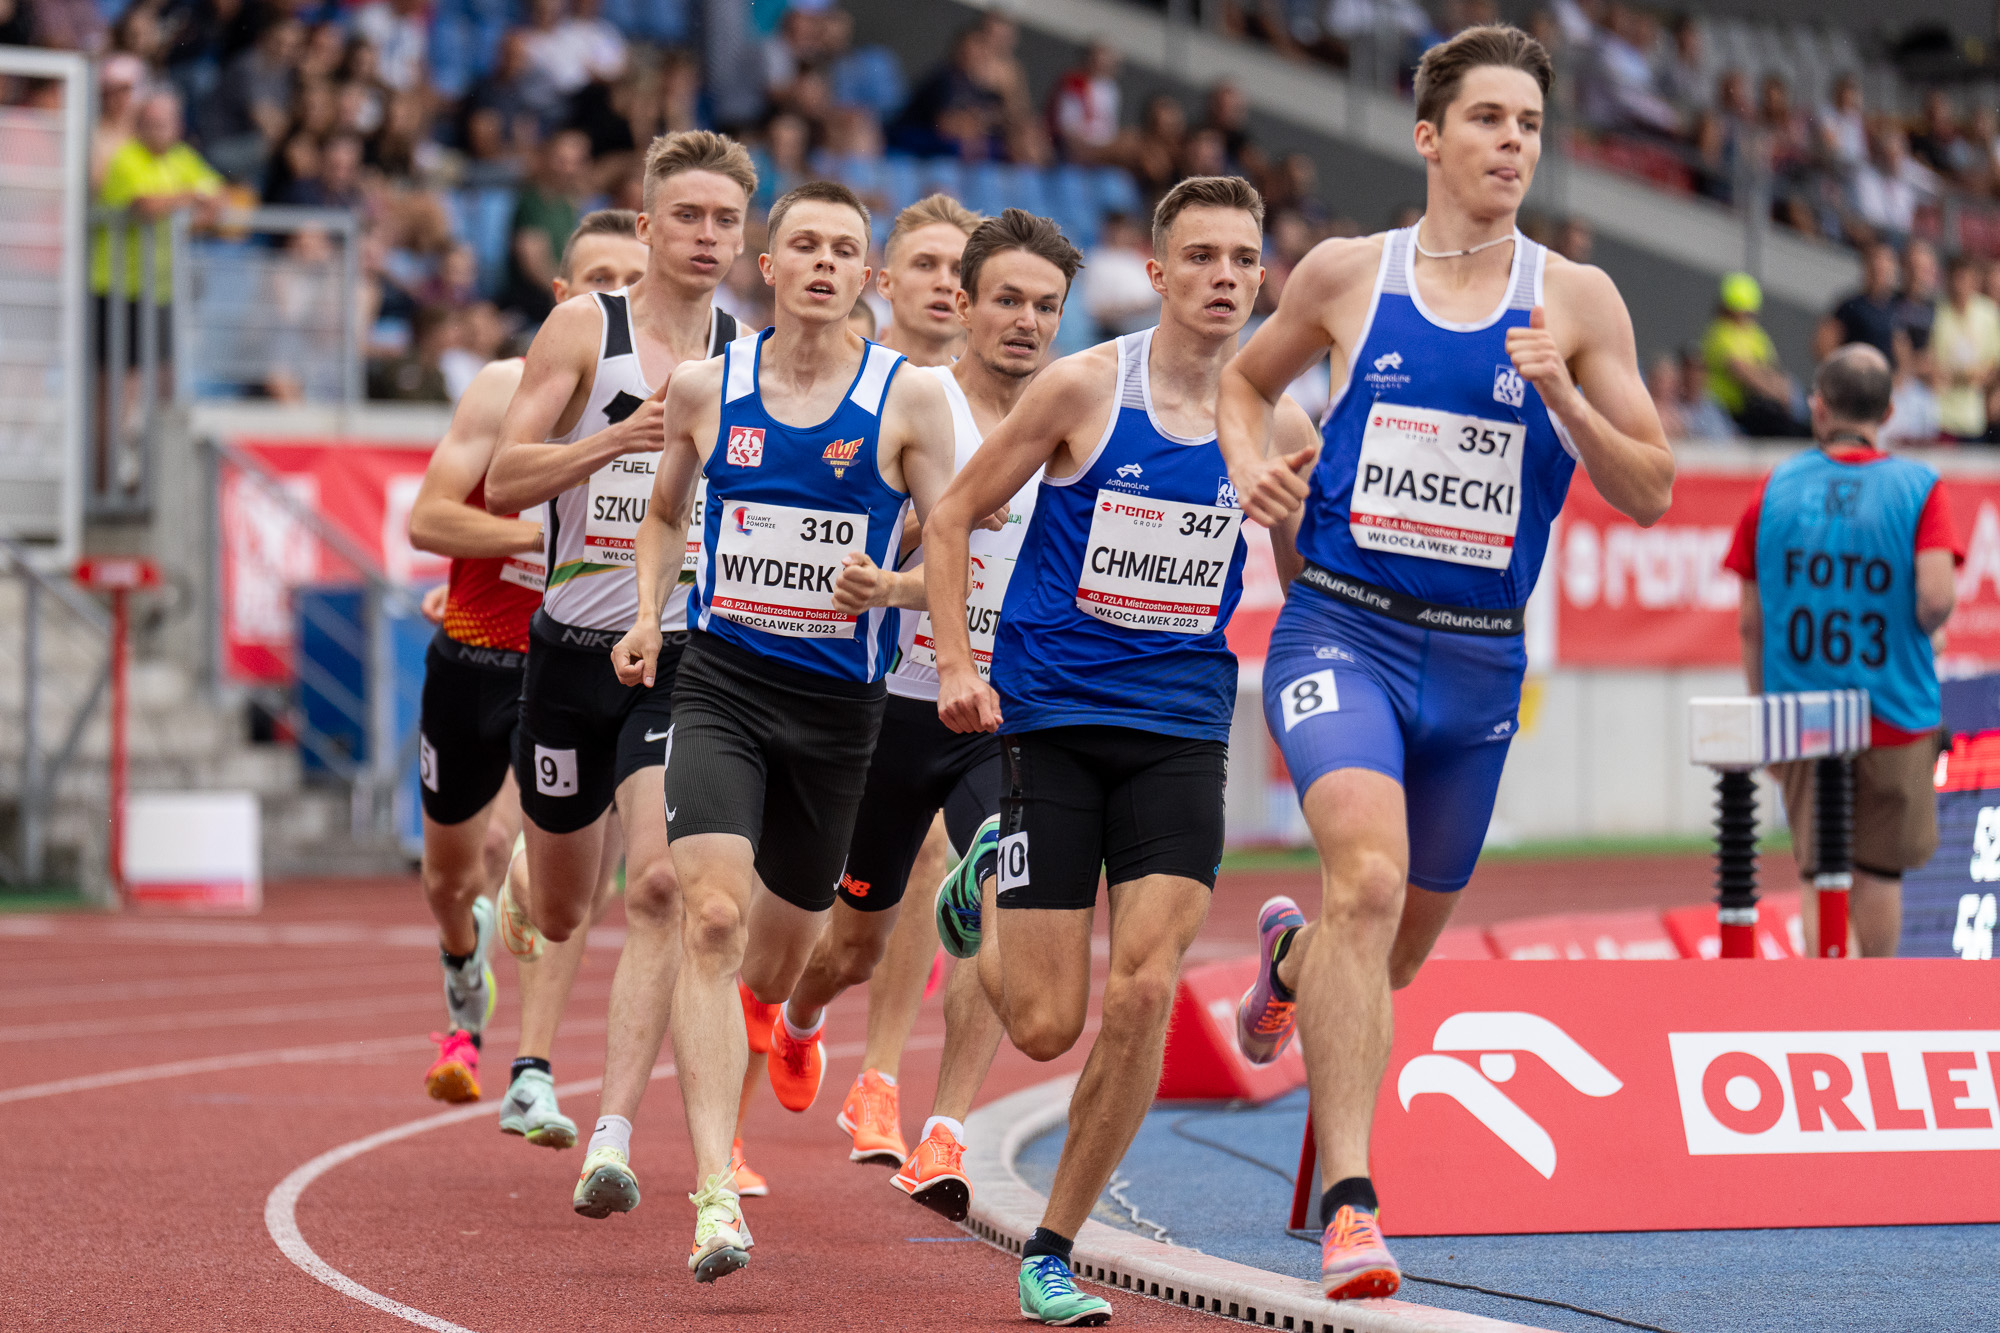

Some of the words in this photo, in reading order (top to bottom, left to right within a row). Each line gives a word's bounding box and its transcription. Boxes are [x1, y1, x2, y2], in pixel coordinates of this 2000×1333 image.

[824, 437, 864, 460] AWF
[1458, 426, 1511, 458] 357
[1362, 464, 1514, 516] PIASECKI
[746, 521, 776, 529] POMORZE
[1115, 504, 1165, 521] renex
[1133, 519, 1163, 528] GROUP
[1179, 512, 1230, 539] 347
[595, 538, 606, 546] 40.
[609, 540, 627, 548] PZLA
[800, 517, 853, 545] 310
[1367, 531, 1458, 555] WŁOCŁAWEK
[1461, 545, 1492, 560] 2023
[722, 553, 847, 593] WYDERK
[1092, 546, 1224, 587] CHMIELARZ
[1785, 550, 1892, 594] FOTO
[721, 599, 733, 608] 40.
[734, 601, 753, 611] PZLA
[753, 605, 803, 618] Mistrzostwa
[805, 610, 831, 620] Polski
[831, 612, 848, 621] U23
[1087, 592, 1101, 602] 40.
[1102, 595, 1123, 606] PZLA
[1124, 599, 1172, 612] Mistrzostwa
[1173, 604, 1195, 614] Polski
[1196, 606, 1211, 615] U23
[1094, 606, 1170, 626] WŁOCŁAWEK
[1172, 617, 1199, 628] 2023
[728, 613, 805, 632] WŁOCŁAWEK
[807, 623, 836, 634] 2023
[1416, 608, 1514, 631] AdRunaLine
[1787, 607, 1887, 668] 063
[1293, 680, 1323, 715] 8
[998, 841, 1026, 883] 10
[1702, 1050, 2000, 1136] ORLE
